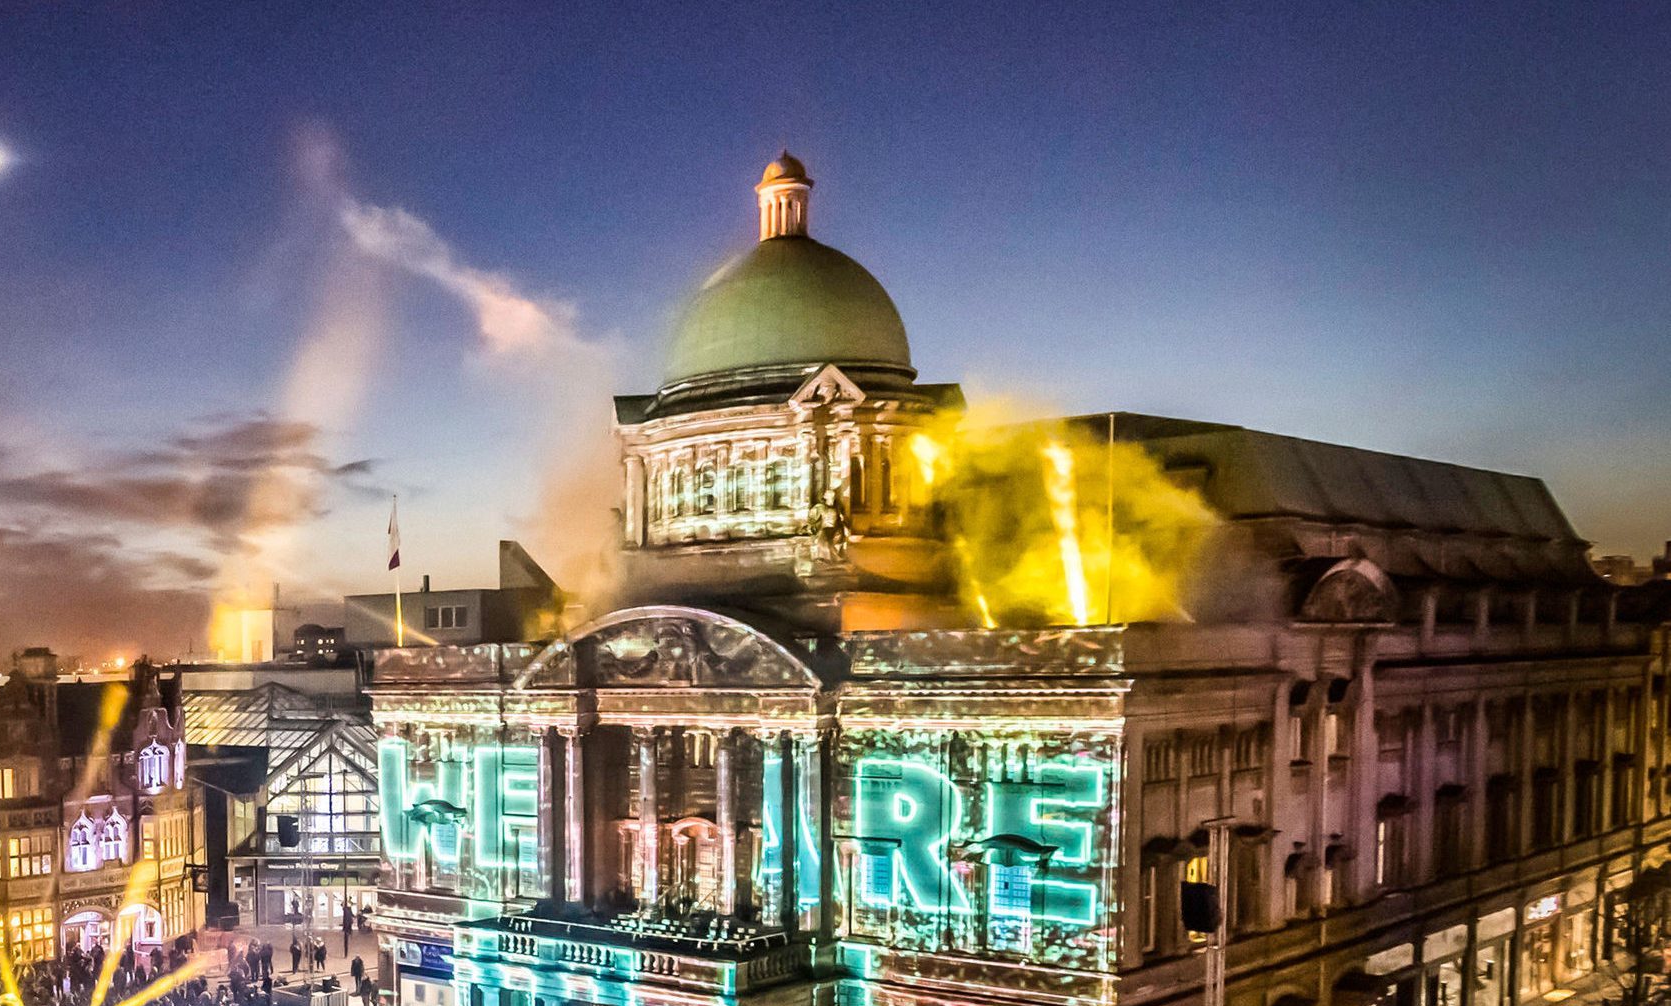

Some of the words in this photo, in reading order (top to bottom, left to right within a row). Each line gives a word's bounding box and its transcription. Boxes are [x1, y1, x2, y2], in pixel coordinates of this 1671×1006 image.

[320, 862, 340, 871] Quay
[377, 738, 539, 871] WE
[751, 755, 1104, 927] ARE
